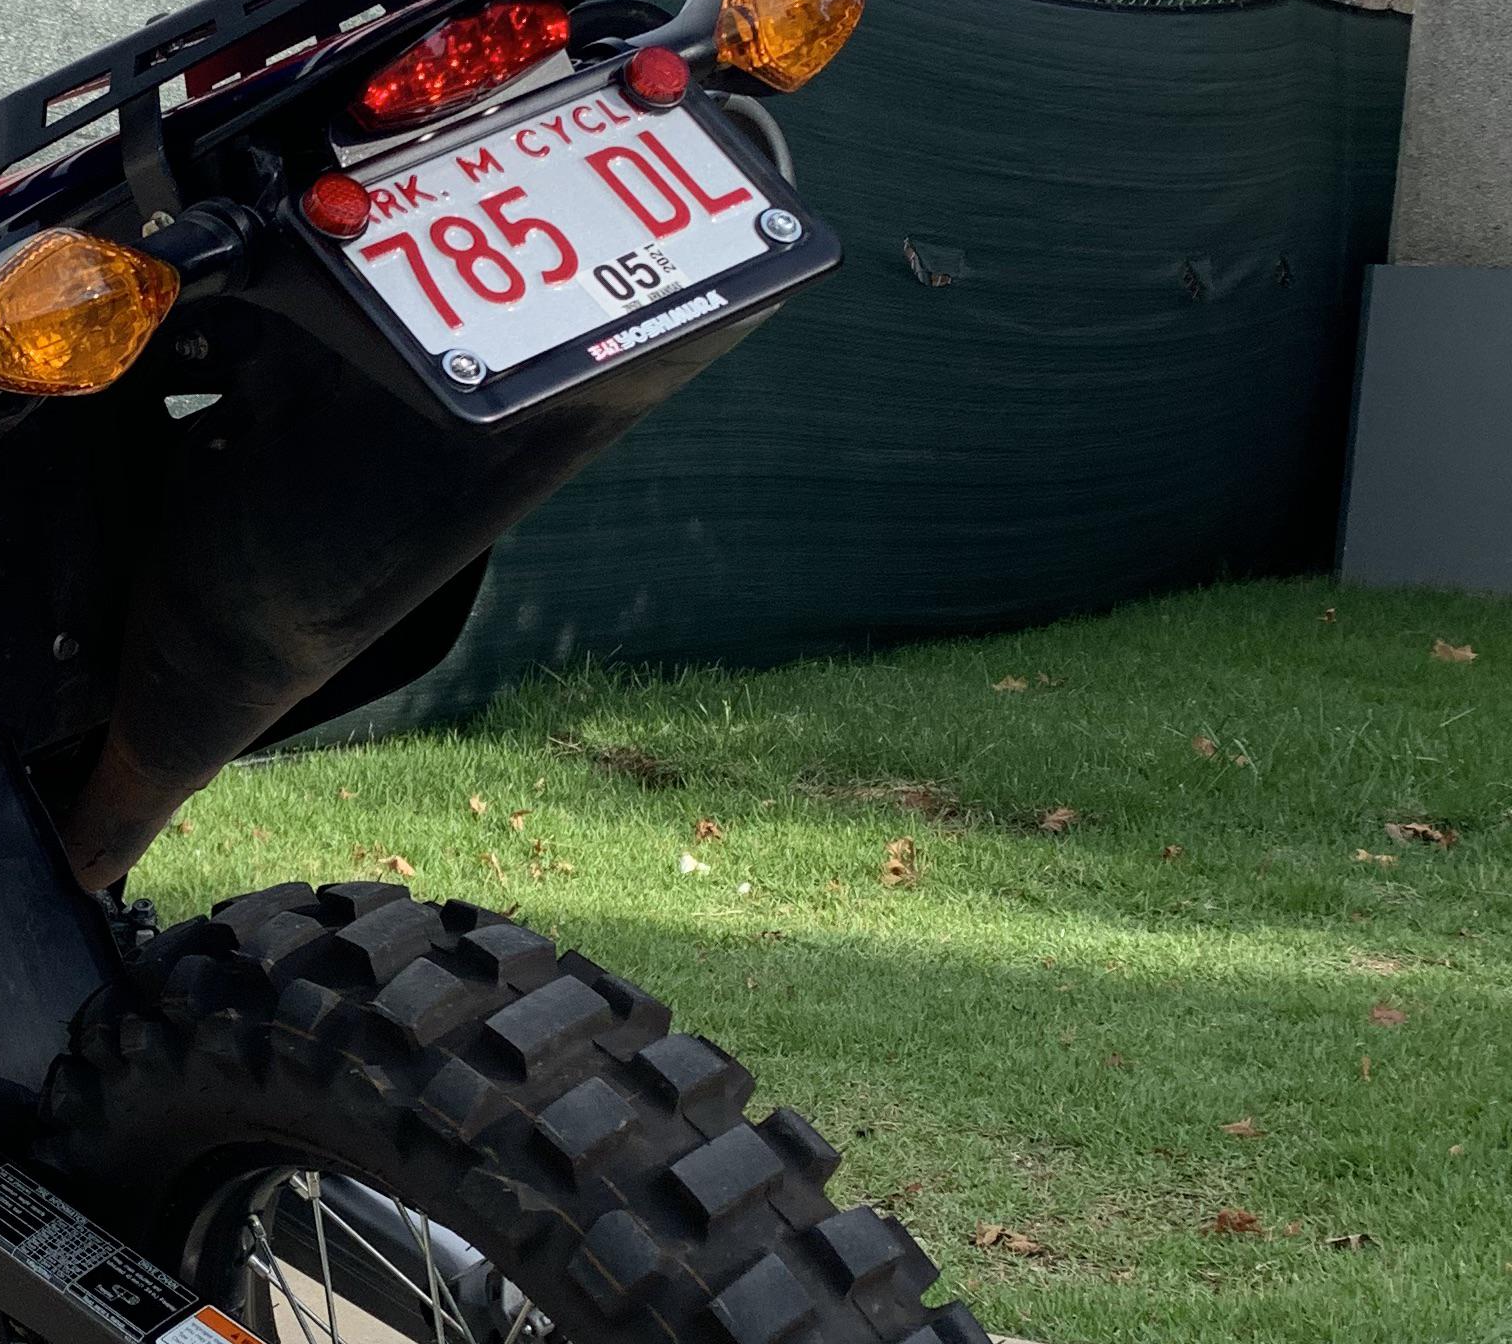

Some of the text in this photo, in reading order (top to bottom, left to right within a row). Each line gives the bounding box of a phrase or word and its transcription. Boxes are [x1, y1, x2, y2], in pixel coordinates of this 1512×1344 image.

[455, 146, 505, 184] M
[360, 130, 755, 330] 785 DL
[592, 251, 661, 301] 05
[643, 242, 677, 274] 2021
[613, 288, 729, 351] YOSHIMURA
